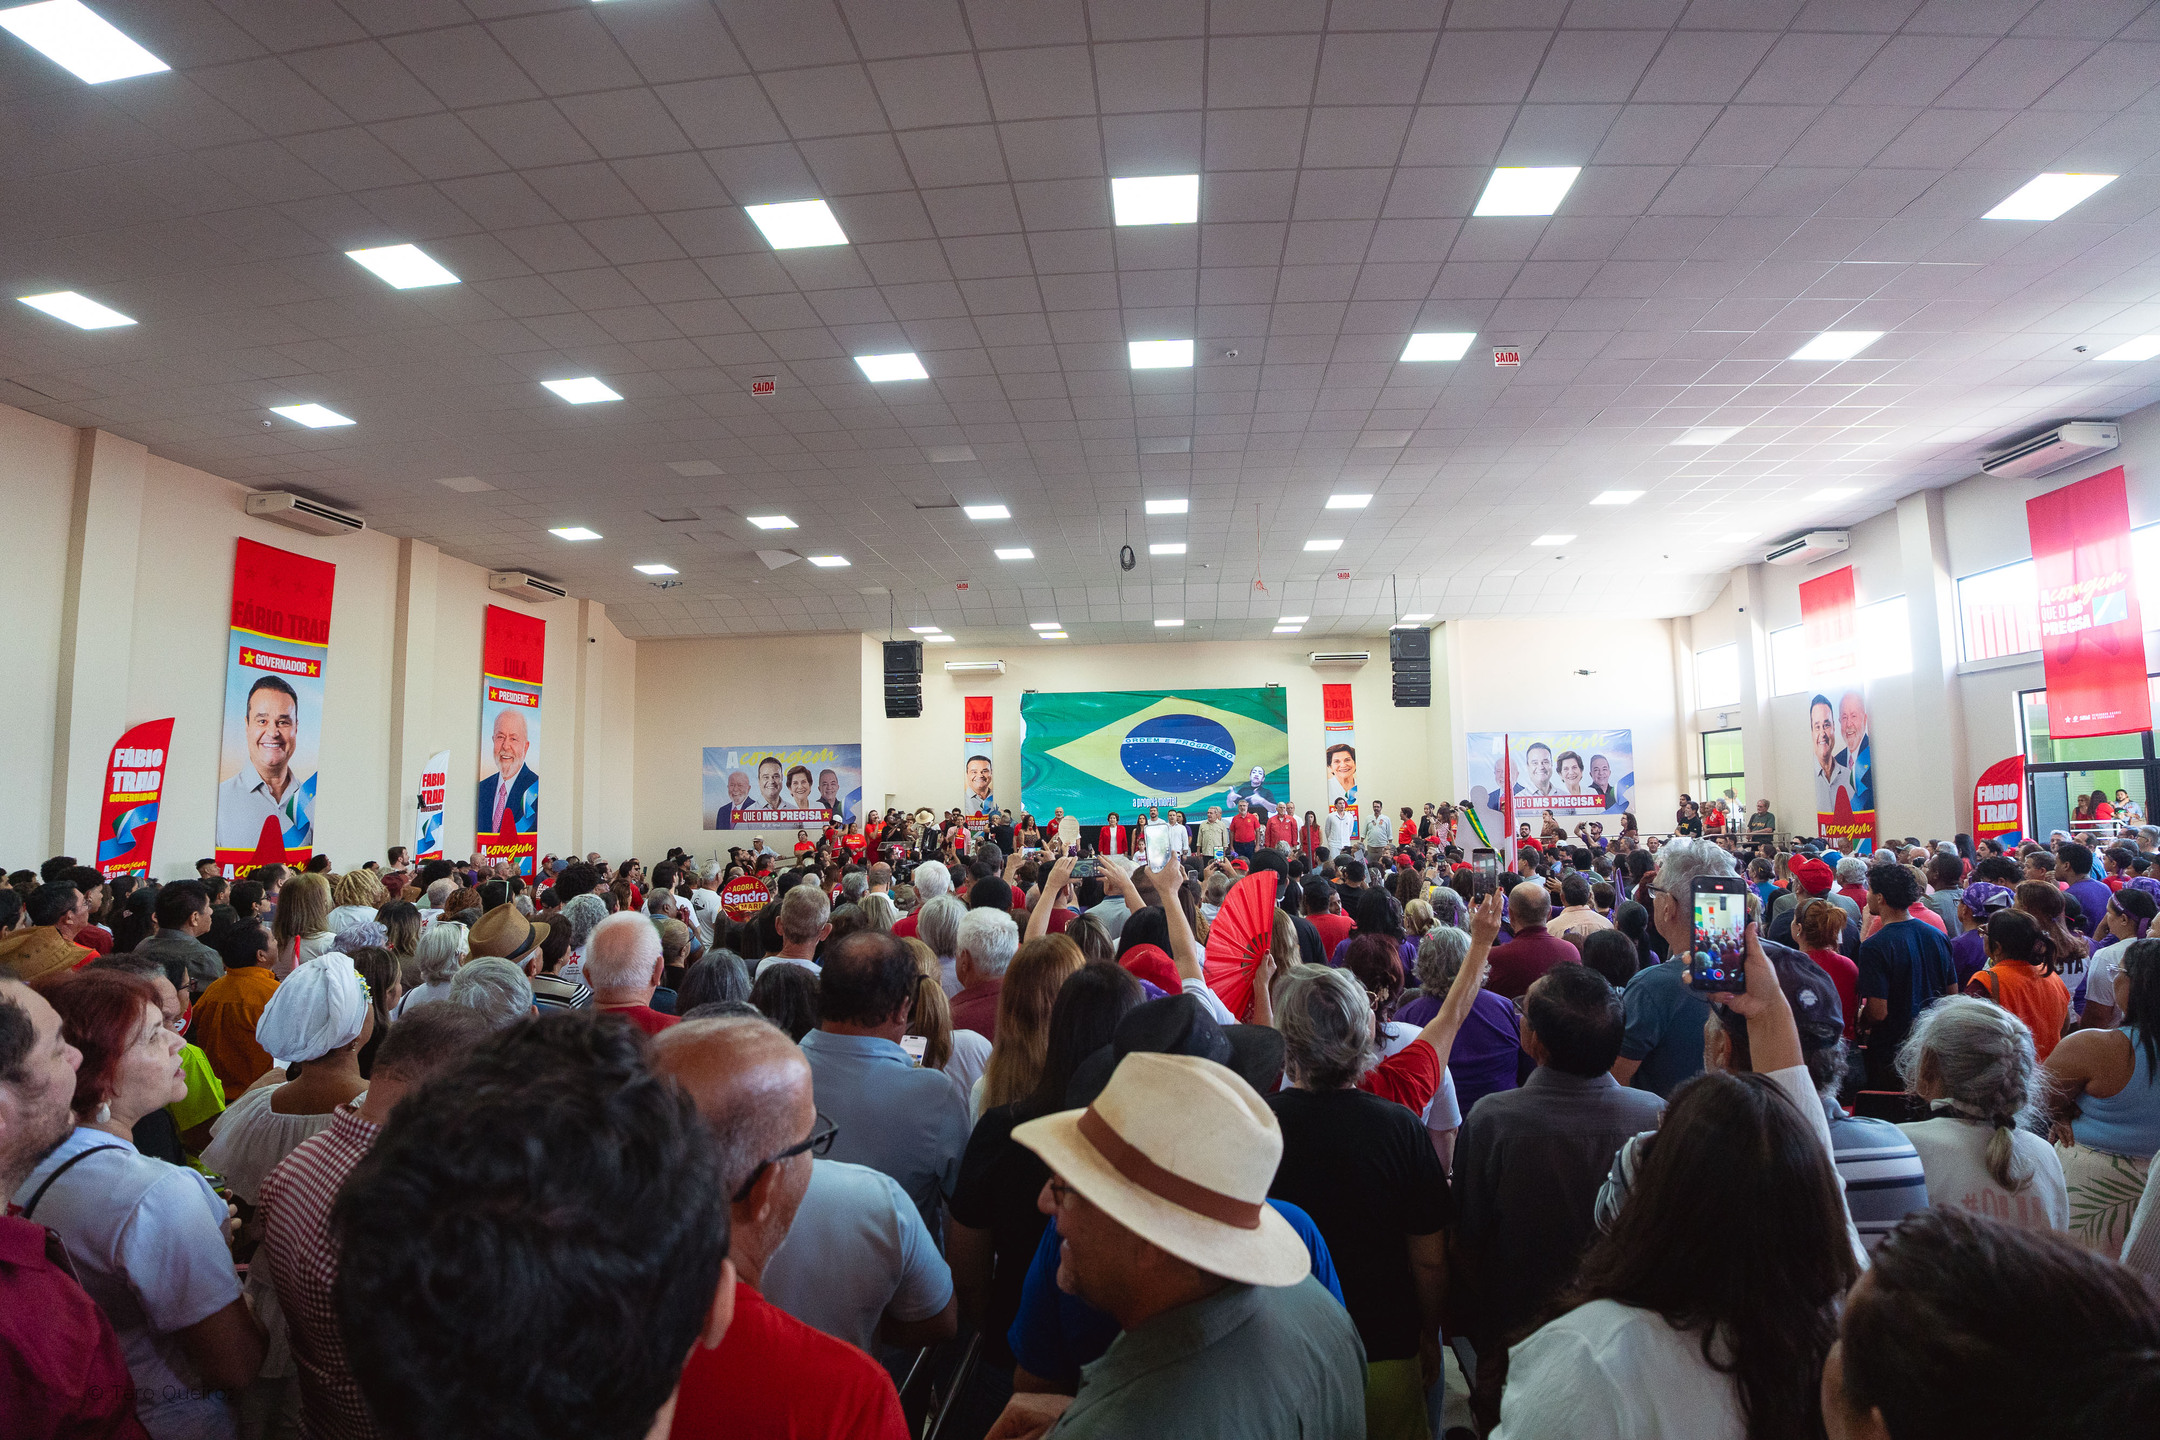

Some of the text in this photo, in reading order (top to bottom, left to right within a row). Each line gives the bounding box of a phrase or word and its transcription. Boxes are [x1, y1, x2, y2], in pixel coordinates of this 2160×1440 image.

[233, 598, 330, 642] FÁBIO TRAD
[2041, 606, 2058, 621] QUE
[2059, 604, 2066, 619] O
[255, 653, 308, 673] GOVERNADOR
[504, 657, 527, 678] LULA
[499, 690, 530, 705] PRESIDENTE
[113, 746, 163, 768] FÁBIO
[1175, 739, 1234, 760] PROGRESSO
[726, 748, 839, 777] A coragem
[112, 771, 161, 792] TRAD
[422, 772, 446, 788] FÁBIO
[1977, 783, 2019, 802] FÁBIO
[1526, 798, 1532, 808] O
[1533, 797, 1549, 808] MS
[1552, 796, 1595, 807] PRECISA
[743, 811, 822, 822] QUE O MS PRECISA
[1978, 803, 2018, 823] TRAD
[1827, 823, 1873, 841] coragem
[1978, 822, 2018, 831] GOVERNADOR
[481, 844, 488, 857] A
[487, 843, 535, 862] coragem
[109, 861, 147, 873] coragem
[222, 864, 235, 880] A
[732, 881, 760, 892] AGORA É
[724, 891, 768, 904] Sandra
